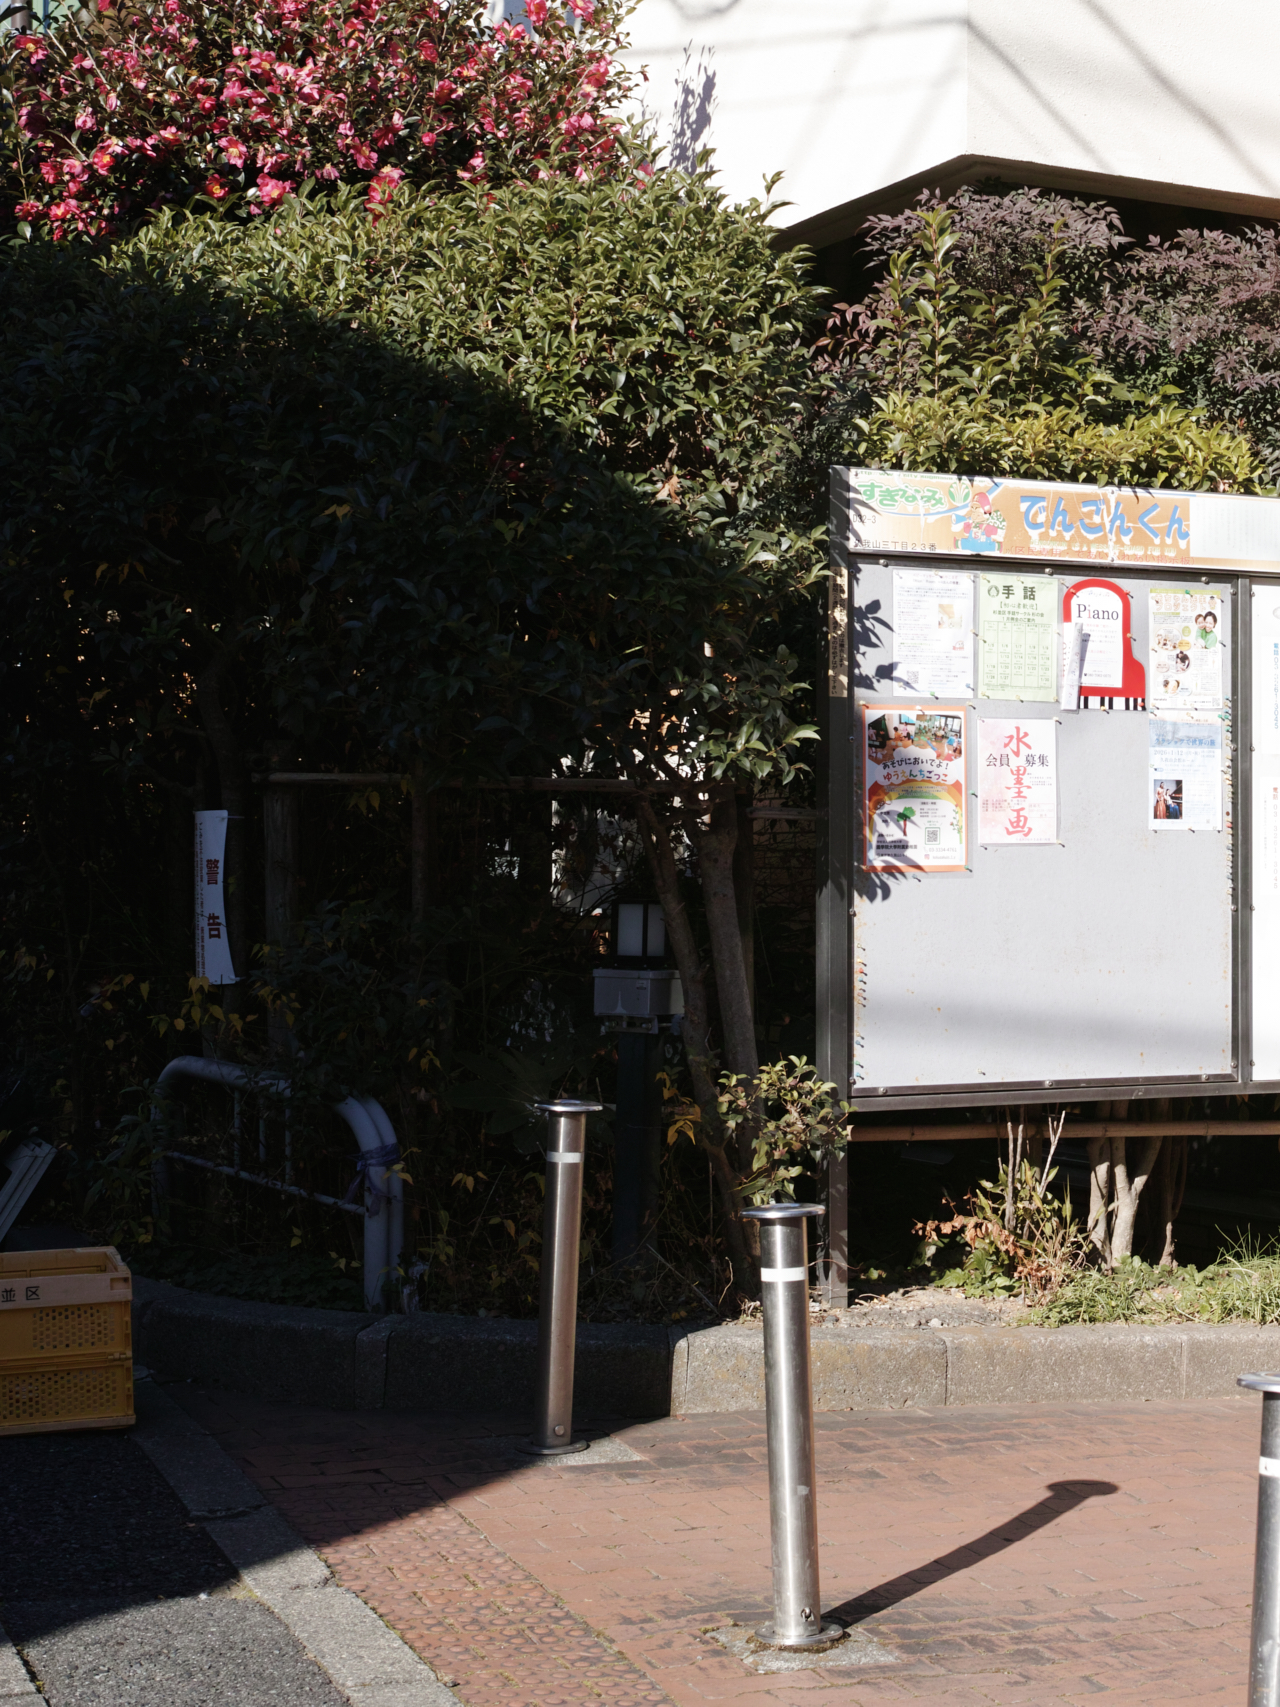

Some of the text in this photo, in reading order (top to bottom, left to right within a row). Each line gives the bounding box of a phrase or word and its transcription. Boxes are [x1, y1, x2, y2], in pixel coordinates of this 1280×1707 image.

[856, 481, 947, 508] すぎなみ
[1020, 495, 1190, 541] でんごんくん
[1075, 603, 1119, 622] Piano
[985, 753, 1049, 767] 会員 募集
[883, 769, 949, 784] ゆうえんちごっこ
[1003, 725, 1033, 838] 水墨画
[206, 858, 222, 940] 警告
